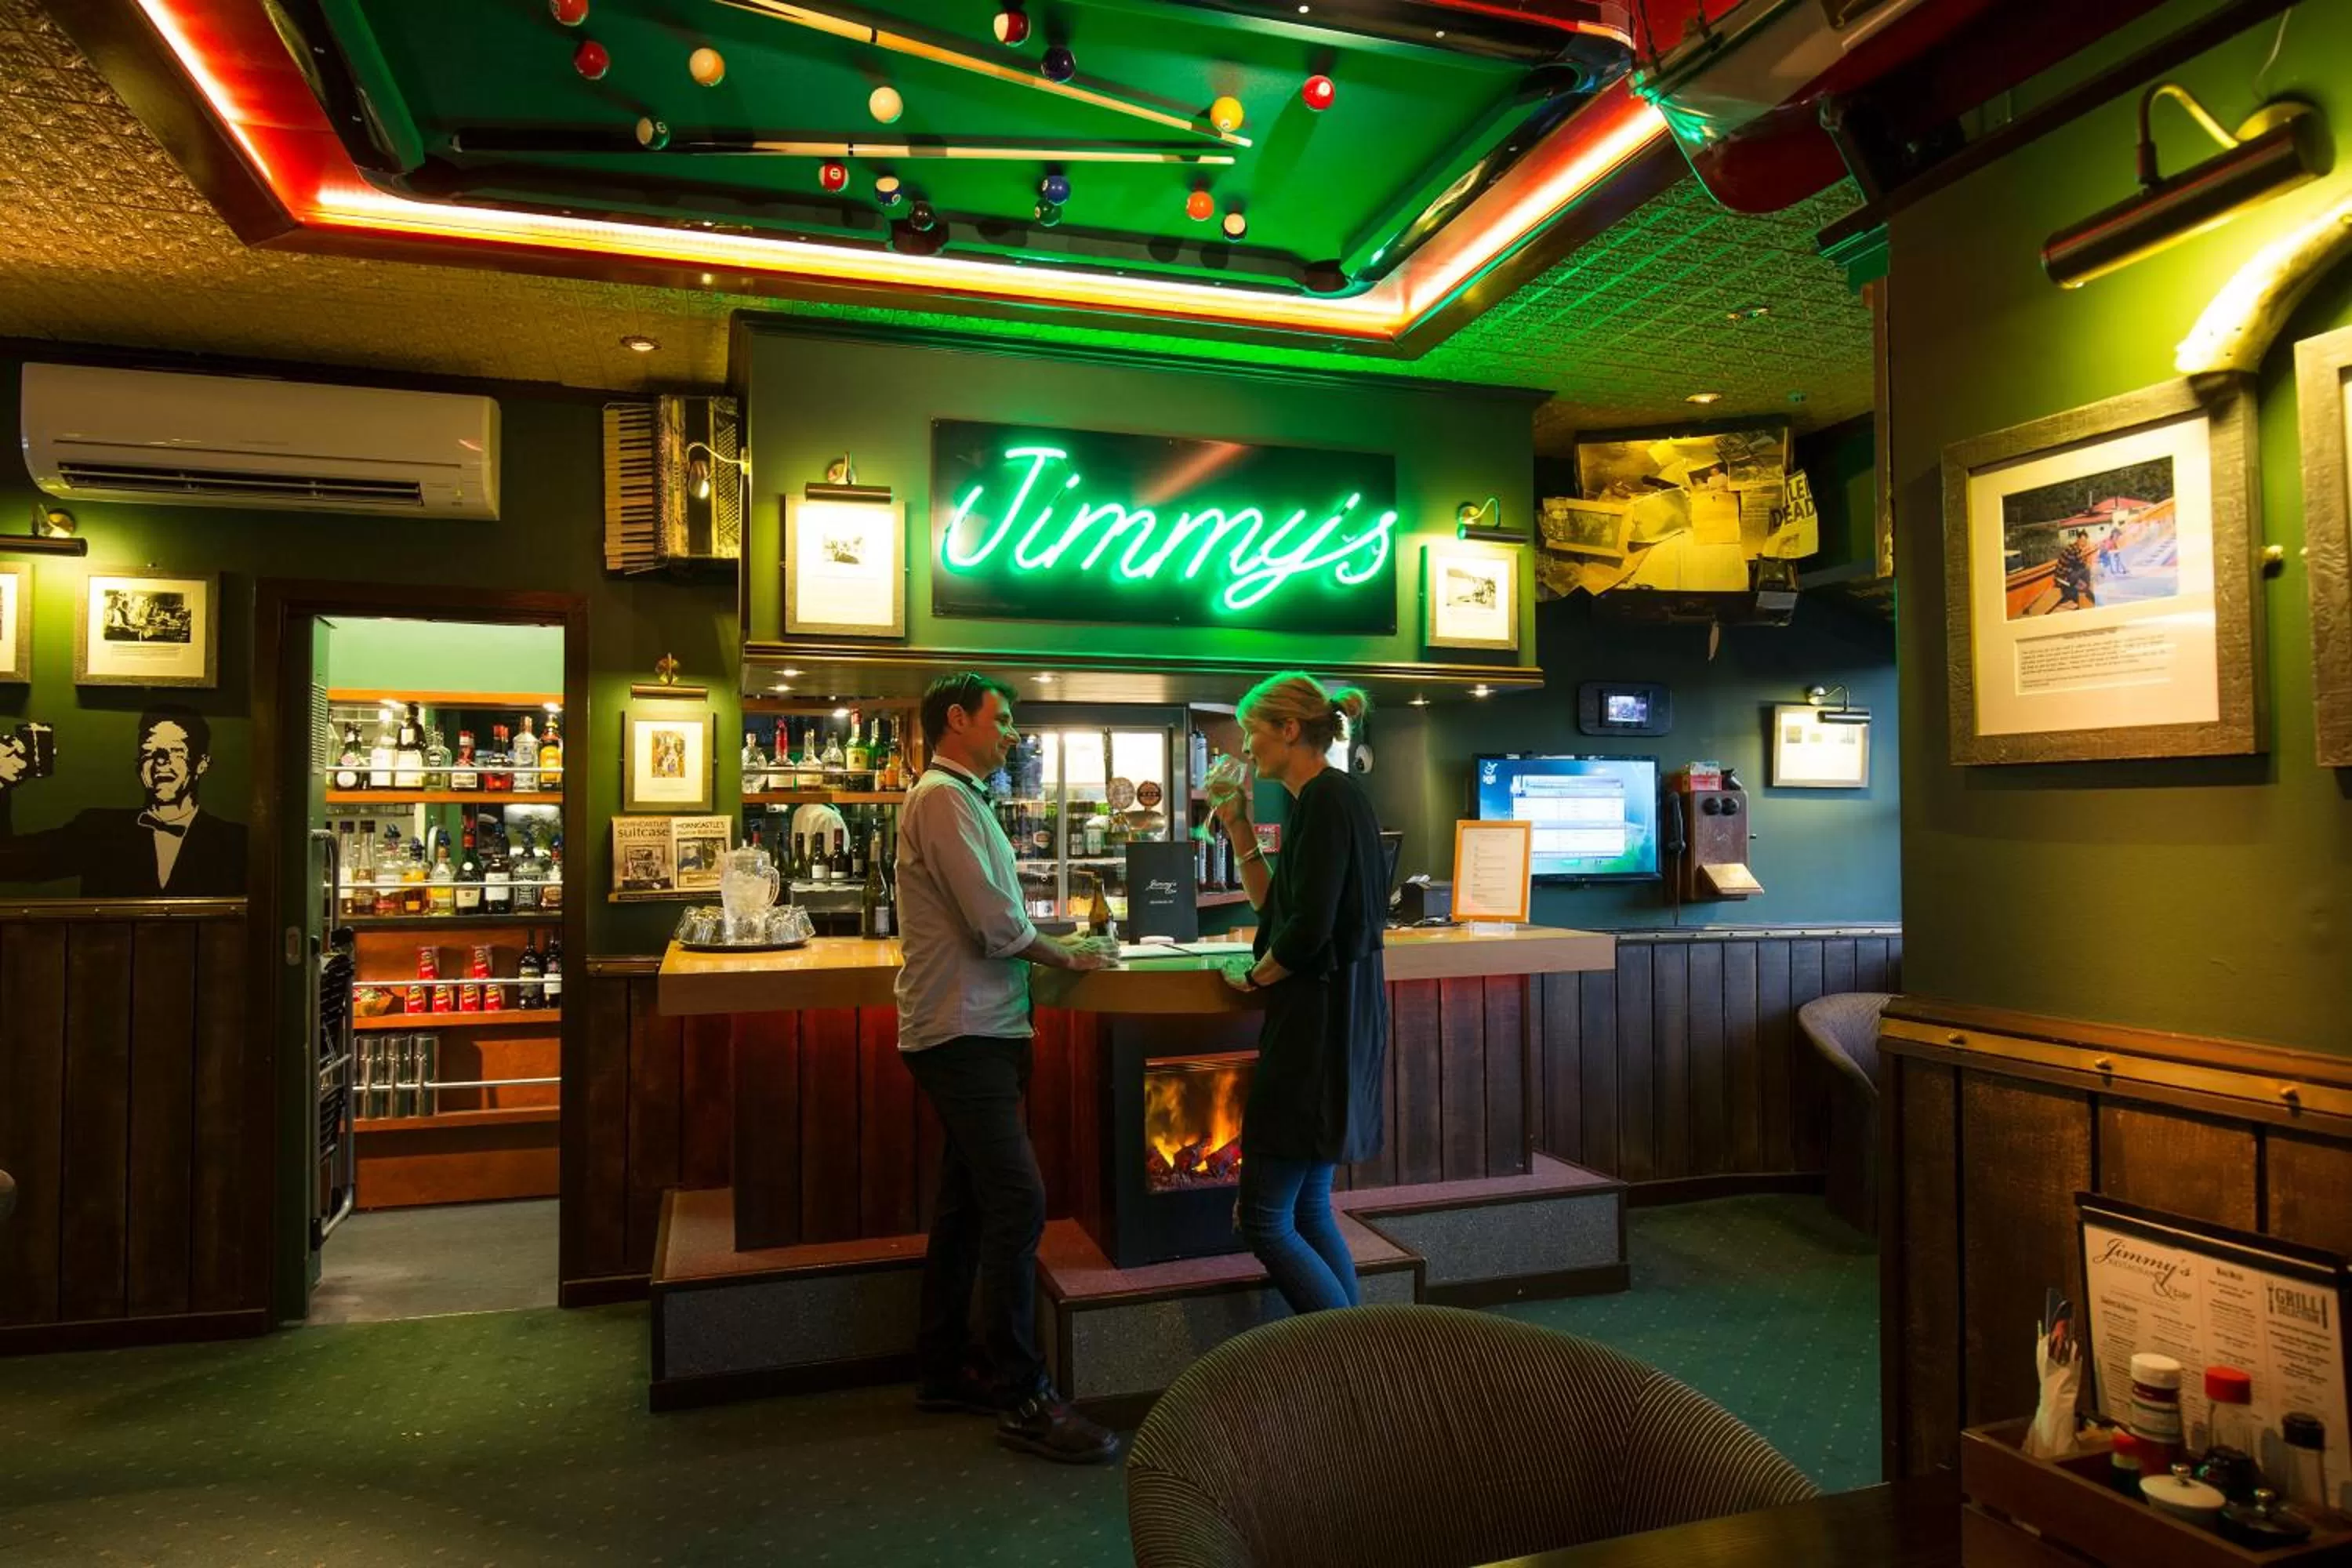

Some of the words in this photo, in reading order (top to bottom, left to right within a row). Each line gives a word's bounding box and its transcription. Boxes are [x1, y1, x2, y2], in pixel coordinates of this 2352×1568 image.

[943, 445, 1399, 610] Jimmy's
[1769, 498, 1815, 530] DEAD
[617, 827, 671, 838] suitcase
[2092, 1238, 2191, 1287] Jimmy's
[2274, 1287, 2319, 1315] GRILL
